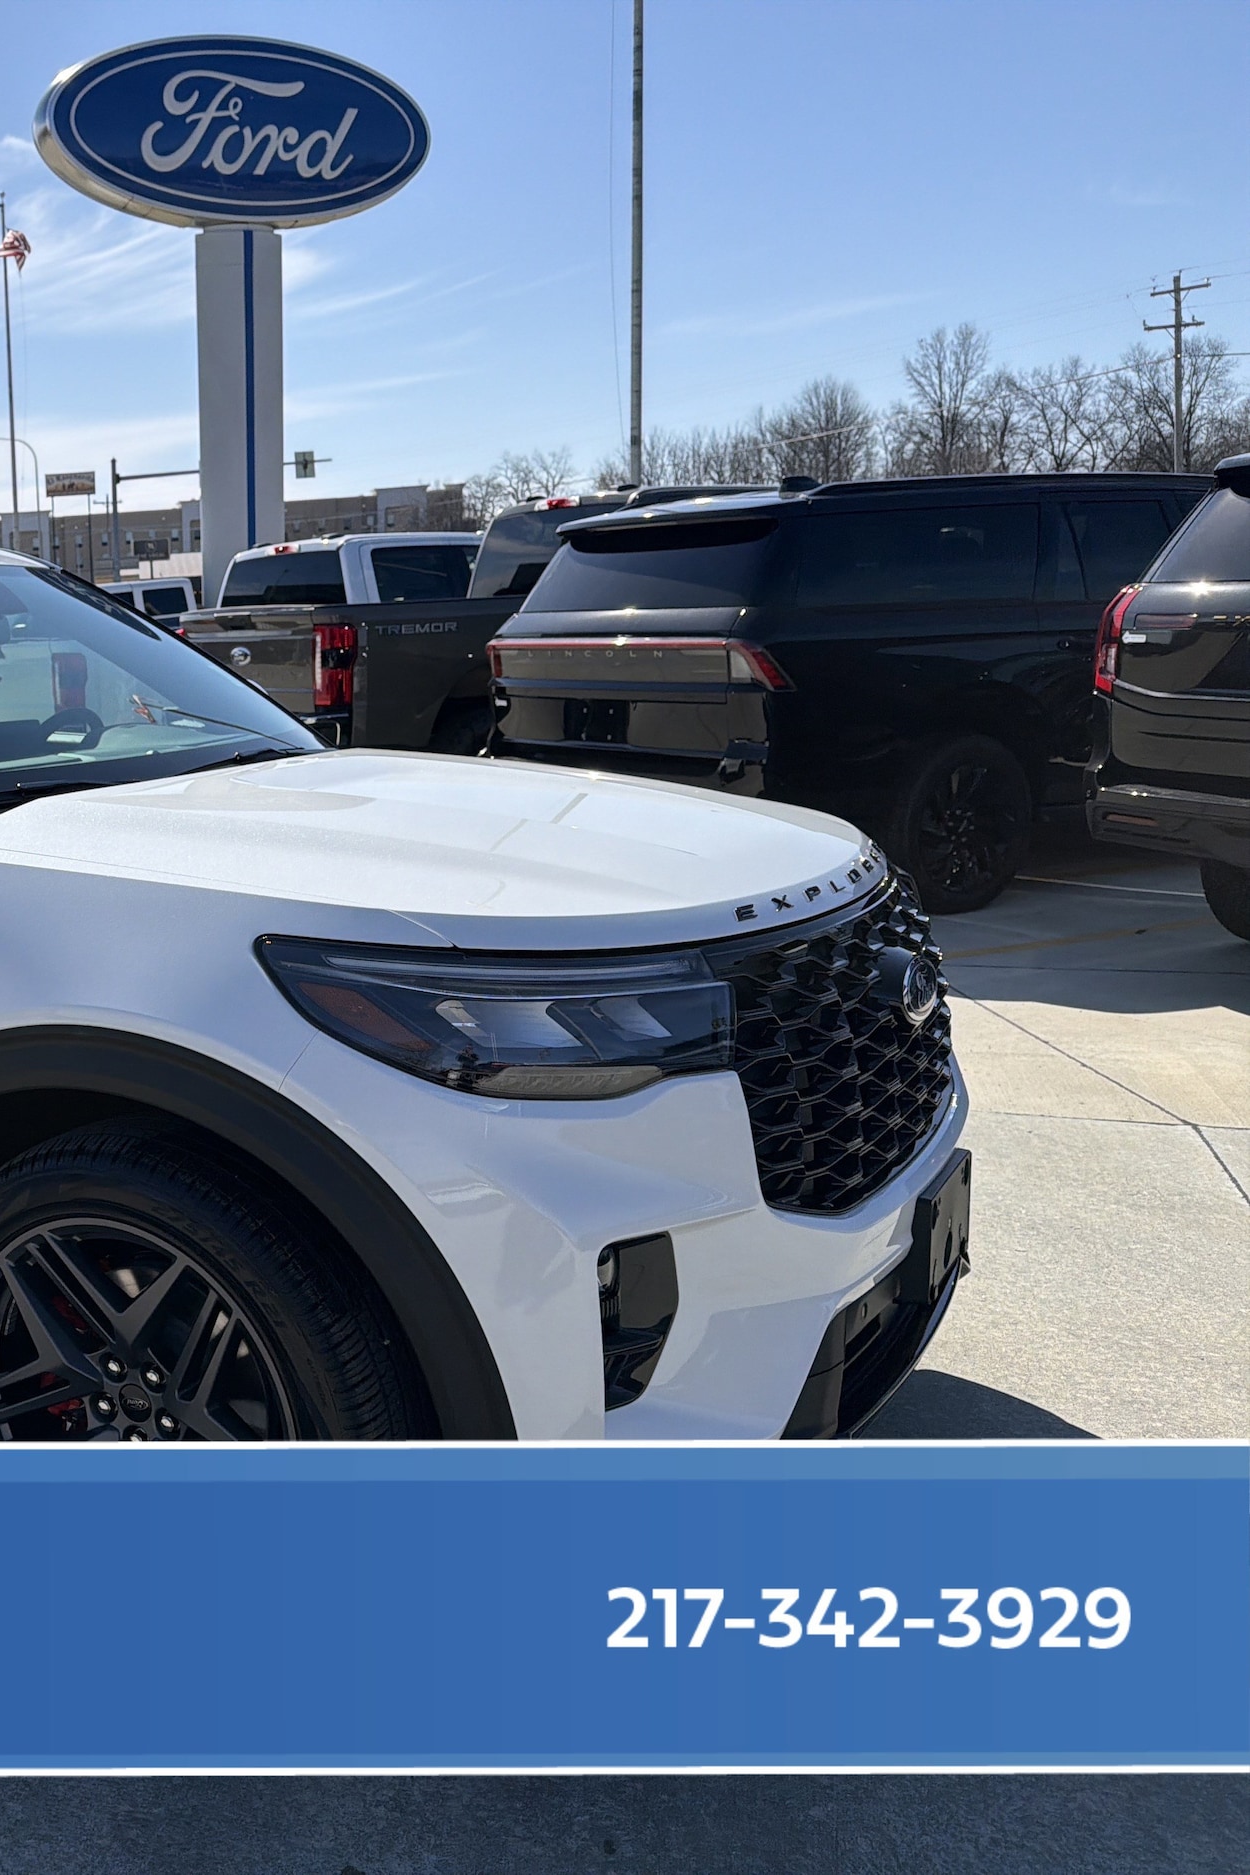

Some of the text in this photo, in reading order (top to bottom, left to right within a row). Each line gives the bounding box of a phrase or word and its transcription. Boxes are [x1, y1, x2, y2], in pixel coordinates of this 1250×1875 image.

[140, 69, 359, 181] Ford
[375, 621, 459, 636] TREMOR
[527, 650, 663, 658] LINCOLN
